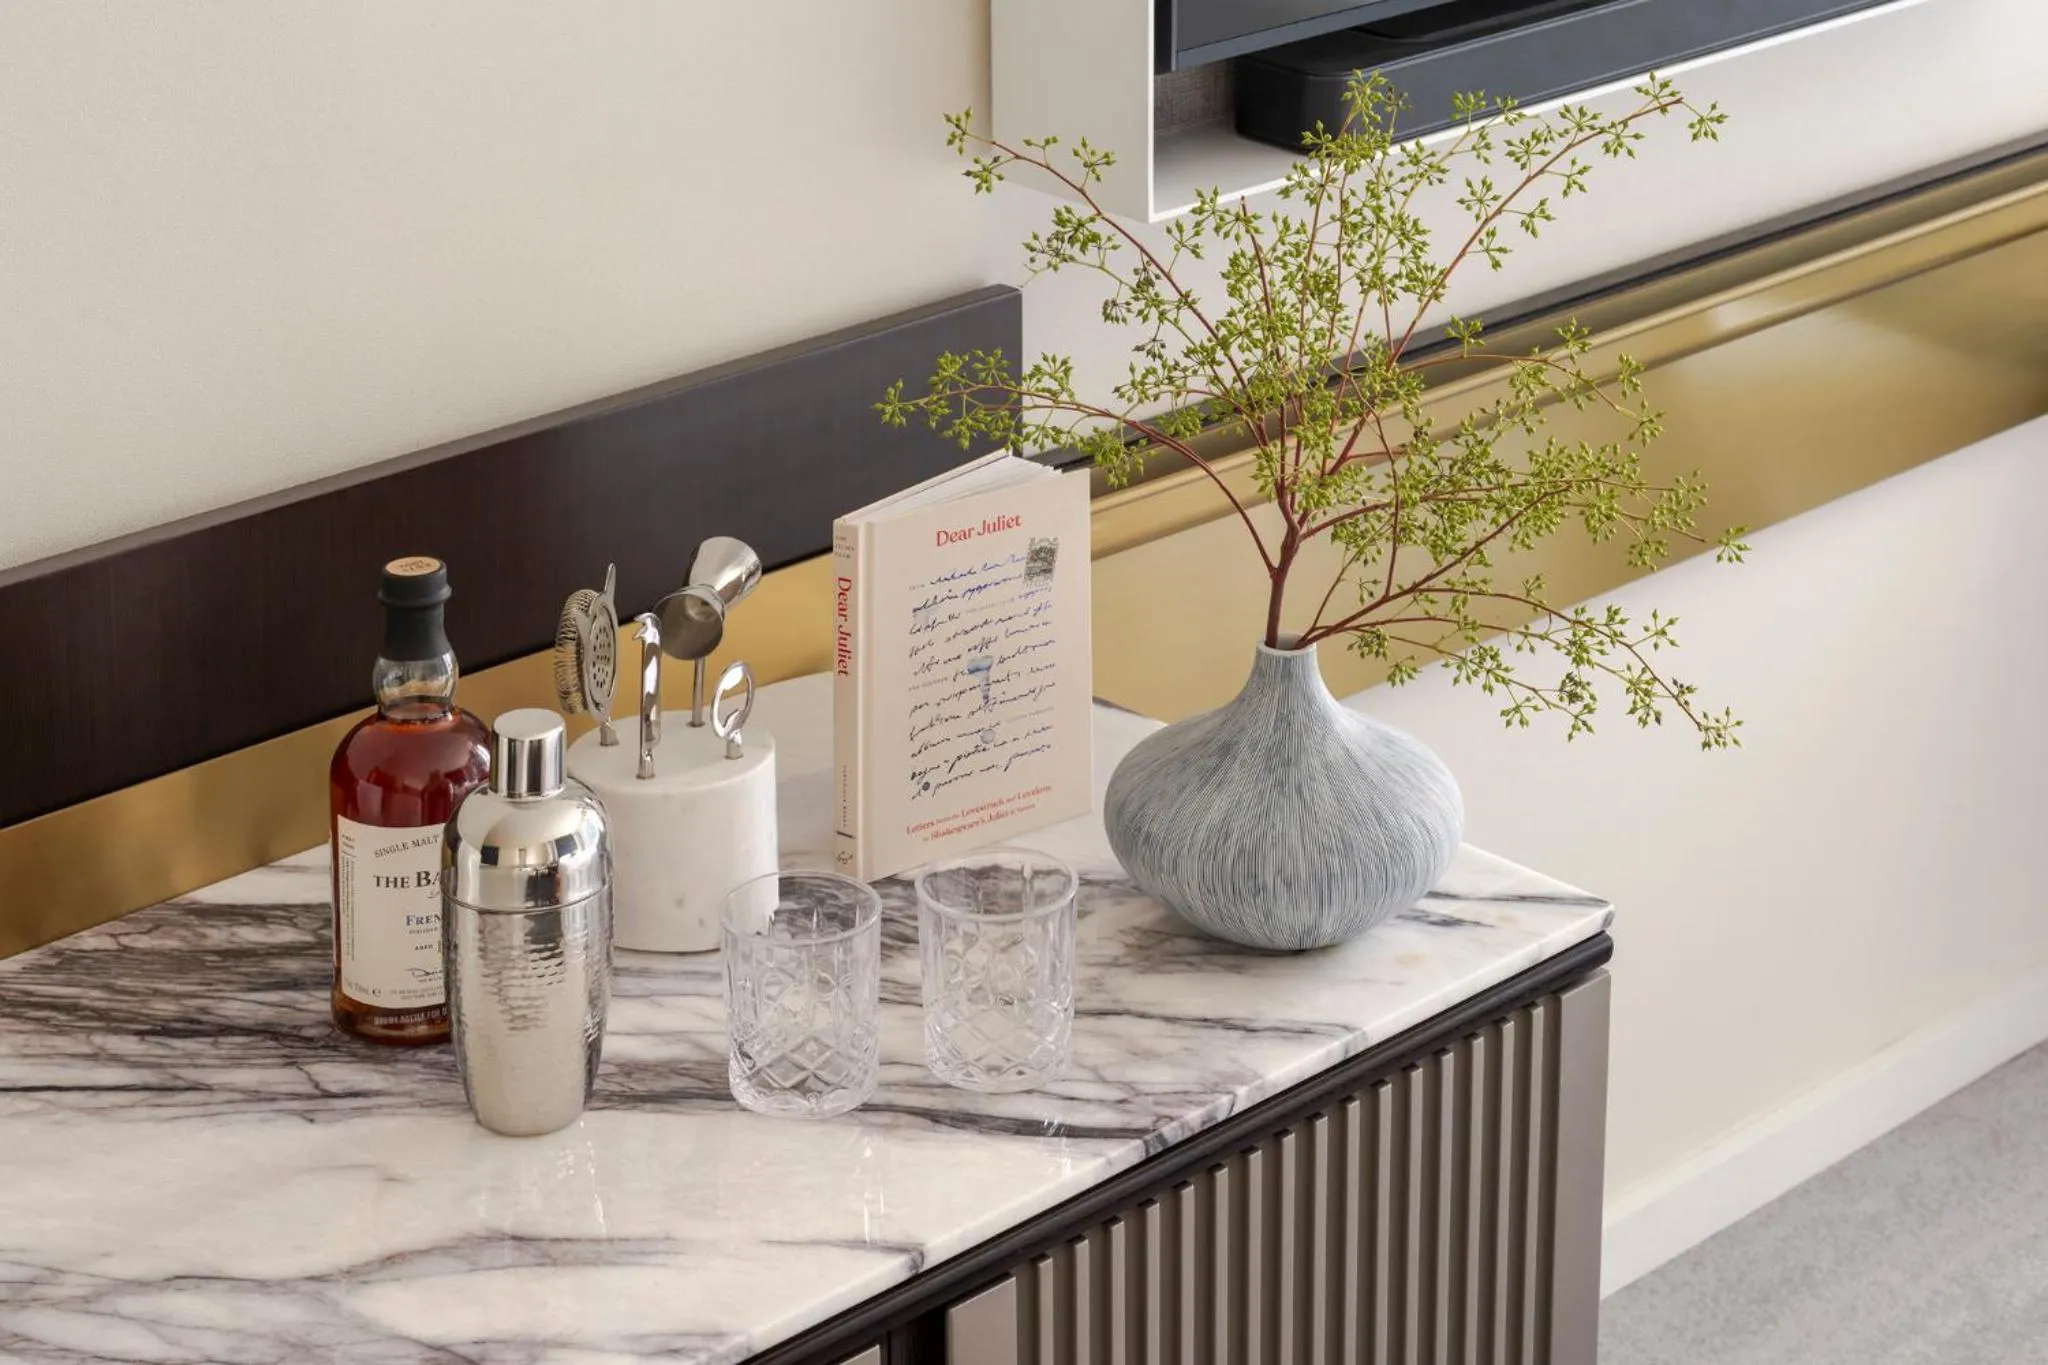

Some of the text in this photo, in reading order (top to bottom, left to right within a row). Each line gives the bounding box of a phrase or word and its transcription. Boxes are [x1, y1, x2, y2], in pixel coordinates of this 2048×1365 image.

[936, 514, 1022, 547] Dear Juliet
[837, 577, 852, 622] Dear
[838, 624, 852, 676] Juliet
[374, 834, 439, 858] SINGLE MALT
[373, 875, 410, 888] THE
